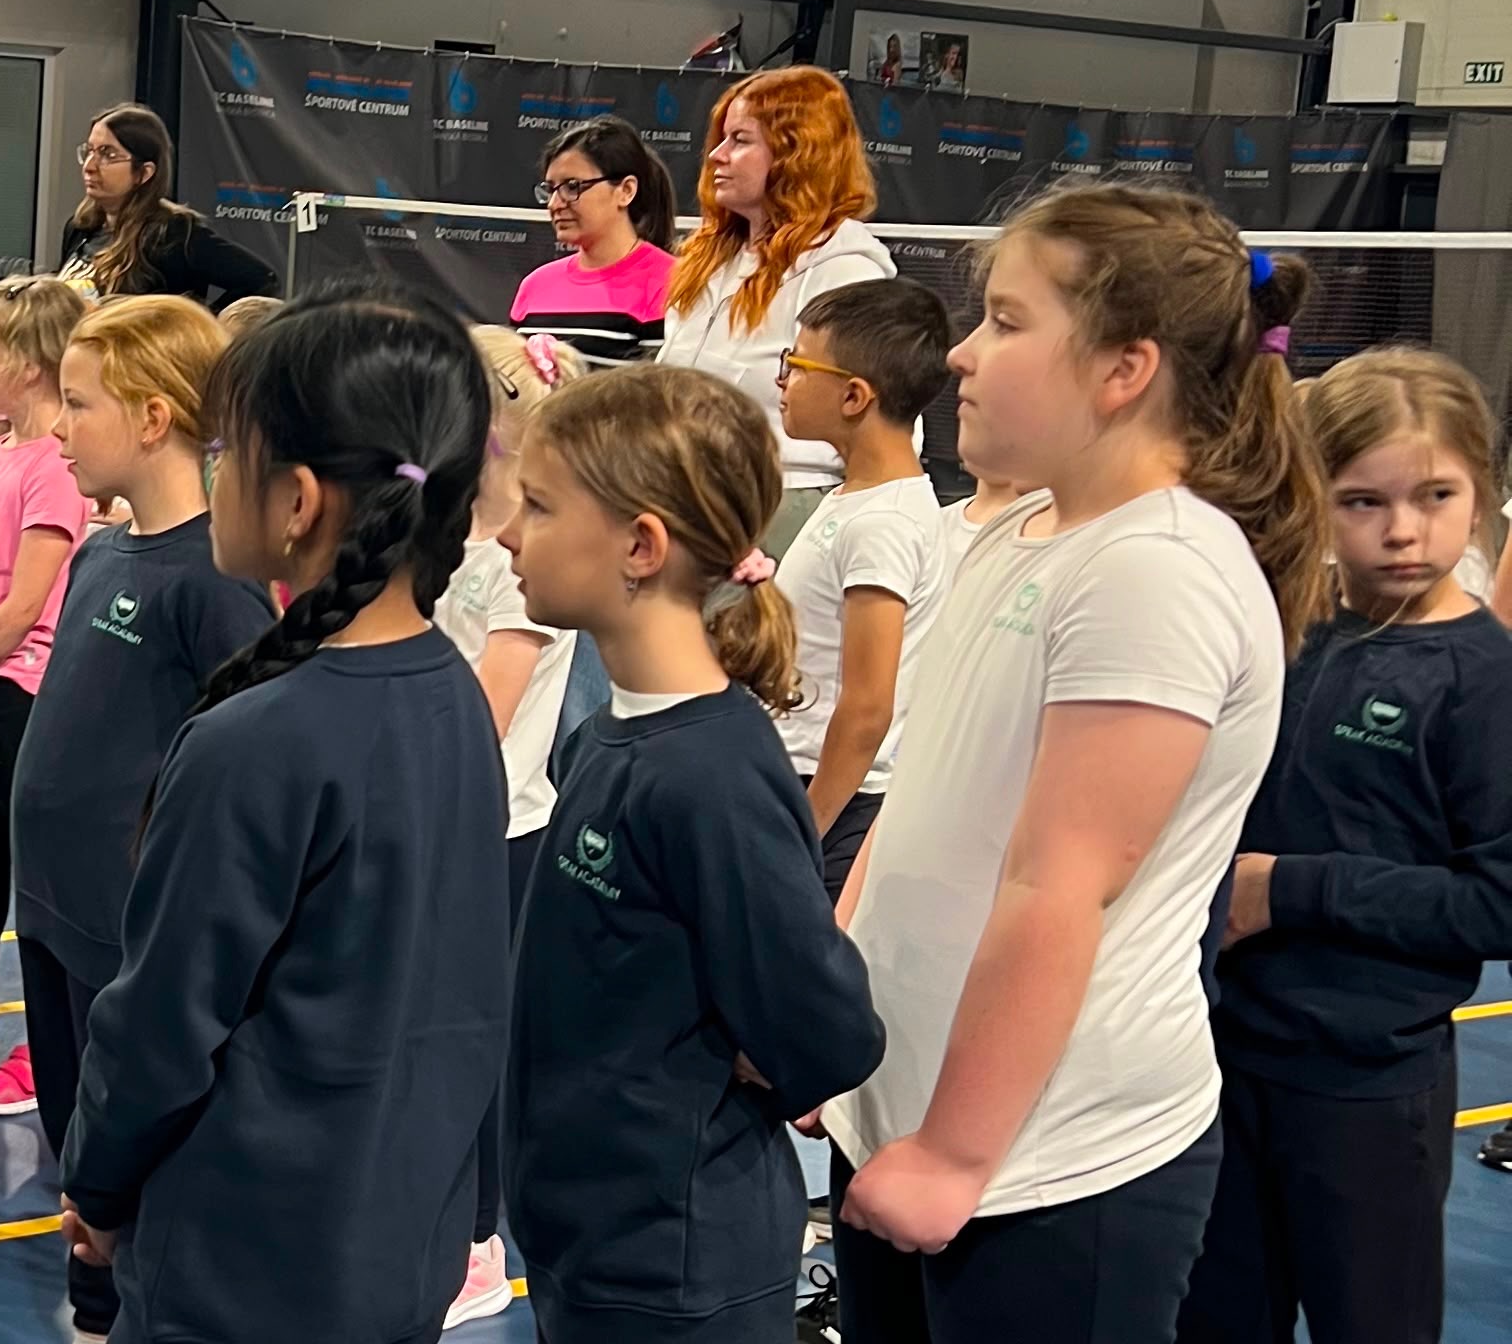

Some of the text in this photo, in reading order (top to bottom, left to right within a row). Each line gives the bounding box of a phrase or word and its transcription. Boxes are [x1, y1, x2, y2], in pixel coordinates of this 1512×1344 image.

[1465, 63, 1504, 83] EXIT
[358, 101, 410, 117] CENTRUM
[302, 200, 311, 226] 1
